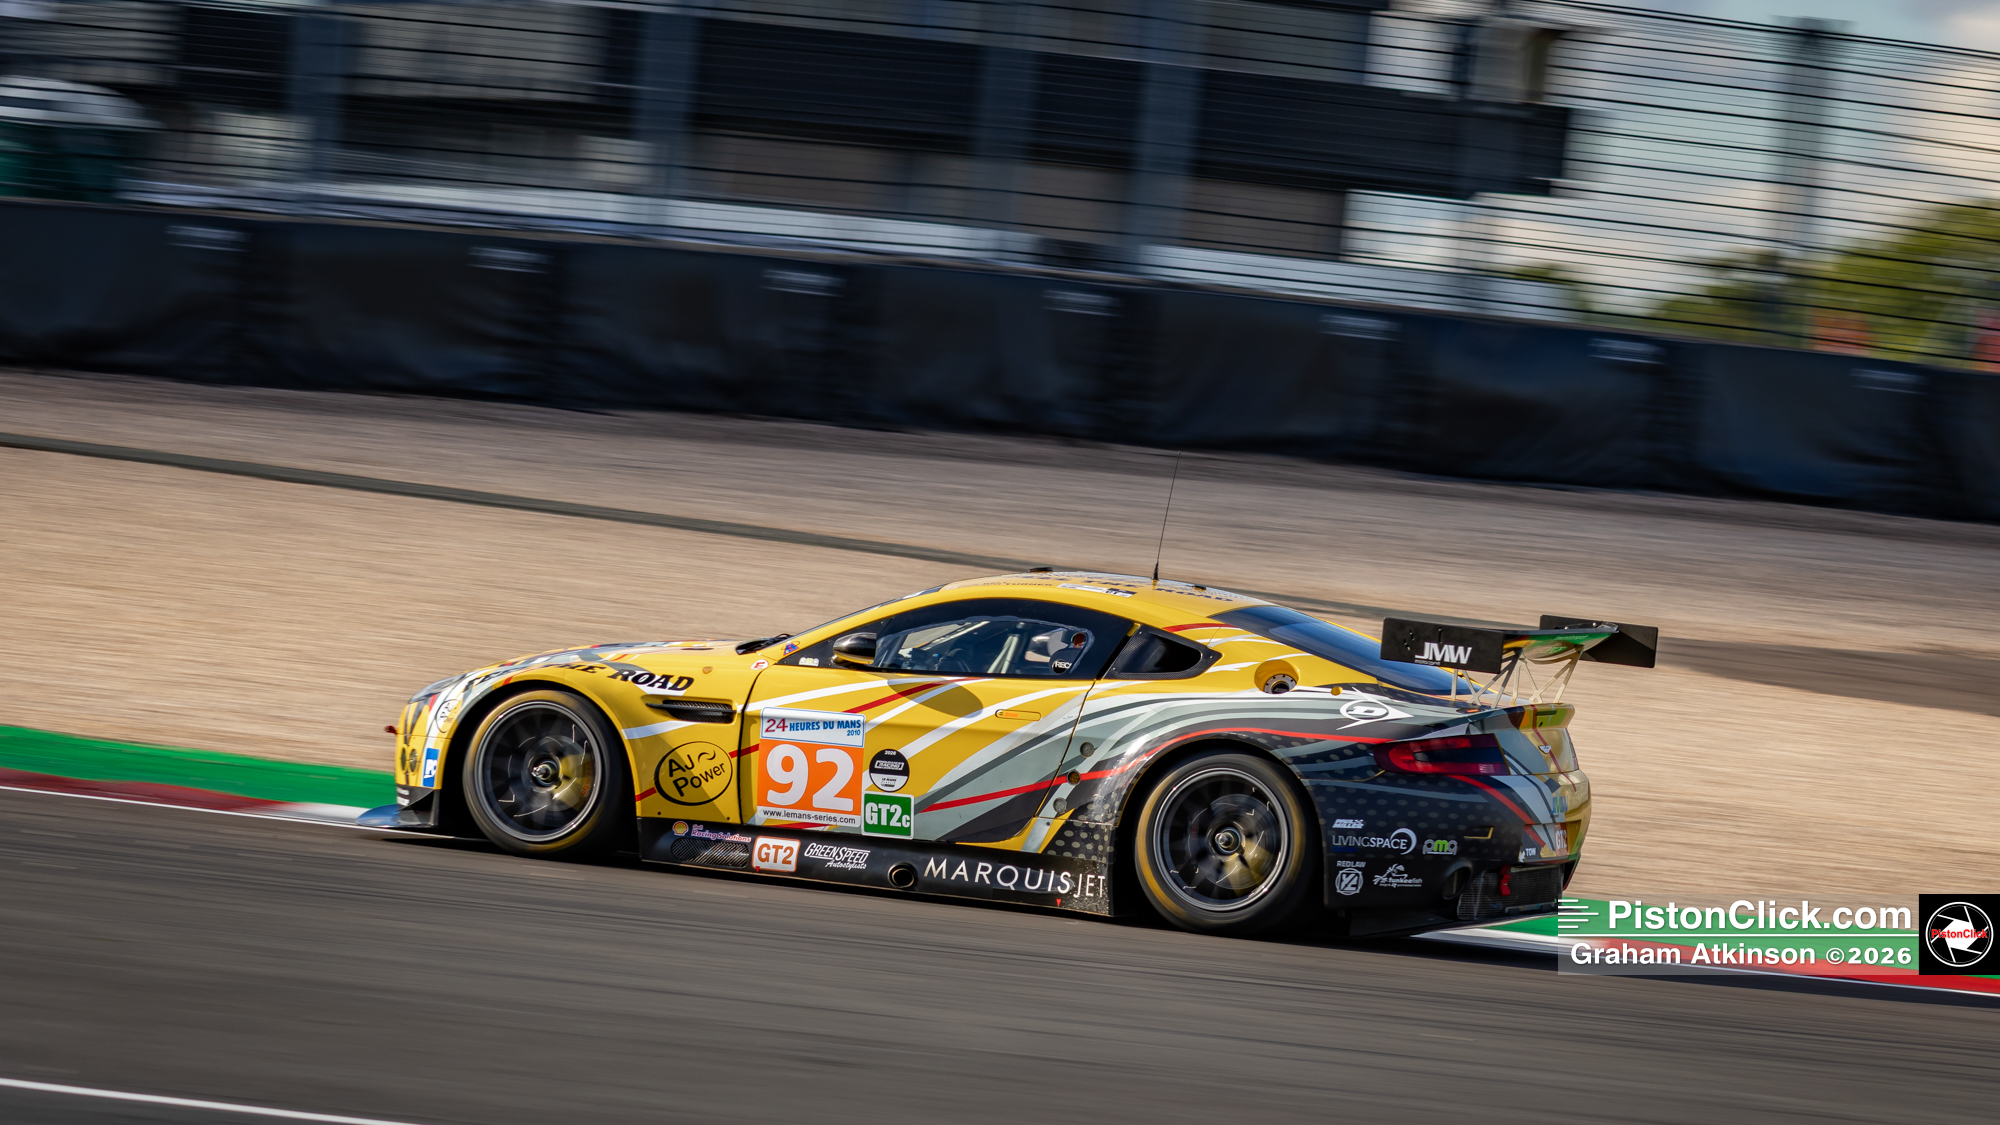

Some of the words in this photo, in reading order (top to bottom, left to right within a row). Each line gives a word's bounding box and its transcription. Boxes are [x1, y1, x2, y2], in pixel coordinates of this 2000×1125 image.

[1415, 642, 1472, 664] JMW
[607, 668, 695, 692] ROAD
[765, 718, 788, 733] 24
[789, 721, 820, 732] HEURES
[823, 721, 835, 730] DU
[837, 719, 861, 730] MANS
[668, 752, 695, 778] AJ
[672, 760, 726, 797] Power
[766, 743, 854, 811] 92
[763, 809, 856, 825] www.lemans-series.com
[691, 829, 717, 840] Racing
[718, 832, 752, 843] Solutions
[1332, 835, 1408, 850] LIVINGSPACE
[1556, 829, 1568, 850] GT2
[757, 843, 794, 865] GT2
